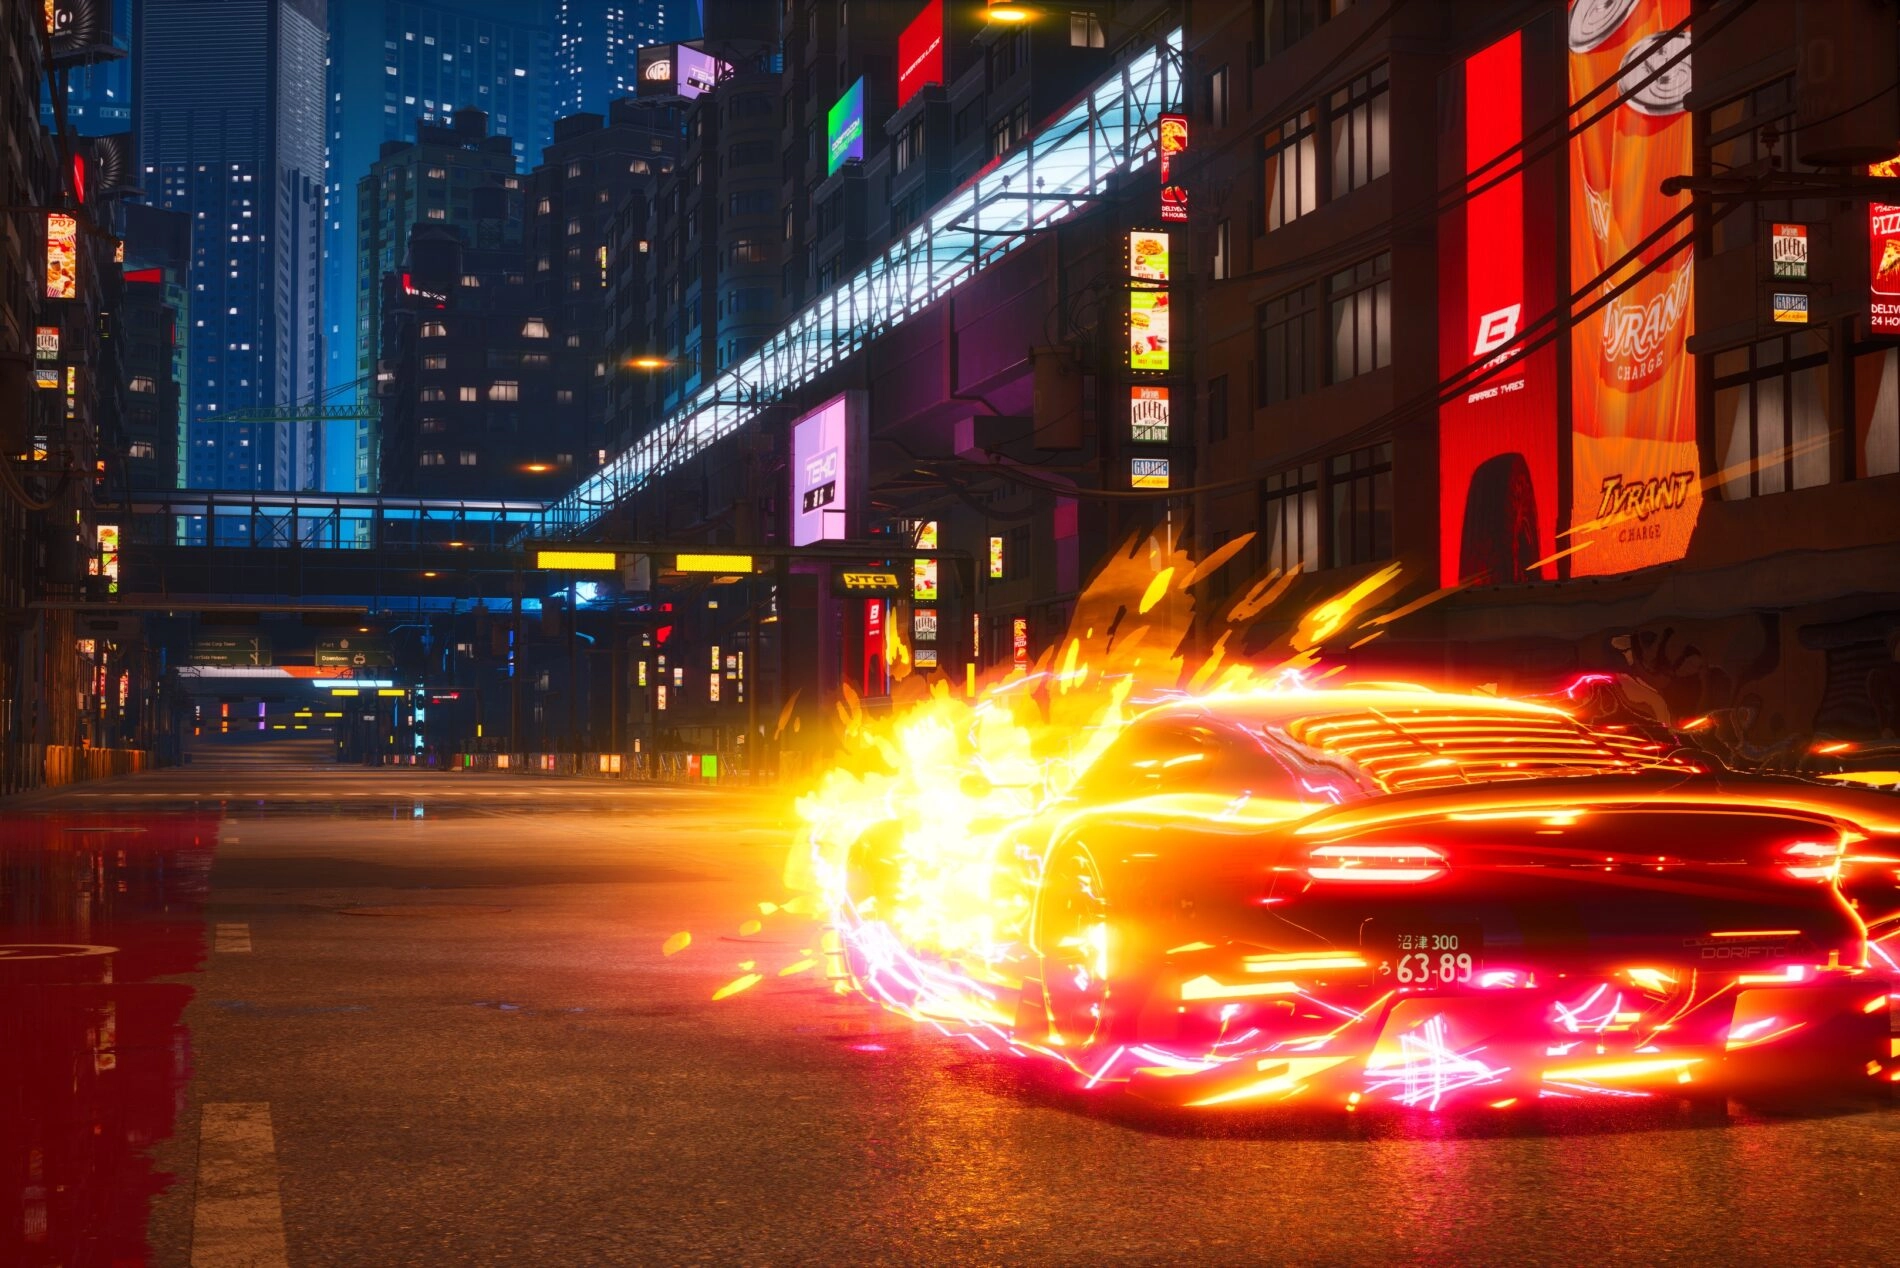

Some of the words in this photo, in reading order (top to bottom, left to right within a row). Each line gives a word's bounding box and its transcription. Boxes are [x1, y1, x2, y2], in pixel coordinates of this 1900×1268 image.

[1776, 296, 1806, 310] GARAGE
[1871, 304, 1900, 314] DELIV
[1872, 316, 1882, 325] 24
[1617, 351, 1664, 380] CHARGE
[1501, 379, 1524, 394] TYRES
[1134, 460, 1168, 475] GARAGE
[1596, 471, 1695, 522] TYRANT
[1618, 524, 1661, 543] CHARGE
[1397, 934, 1428, 950] 沼津
[1431, 934, 1459, 950] 300
[1397, 953, 1473, 983] 63-89
